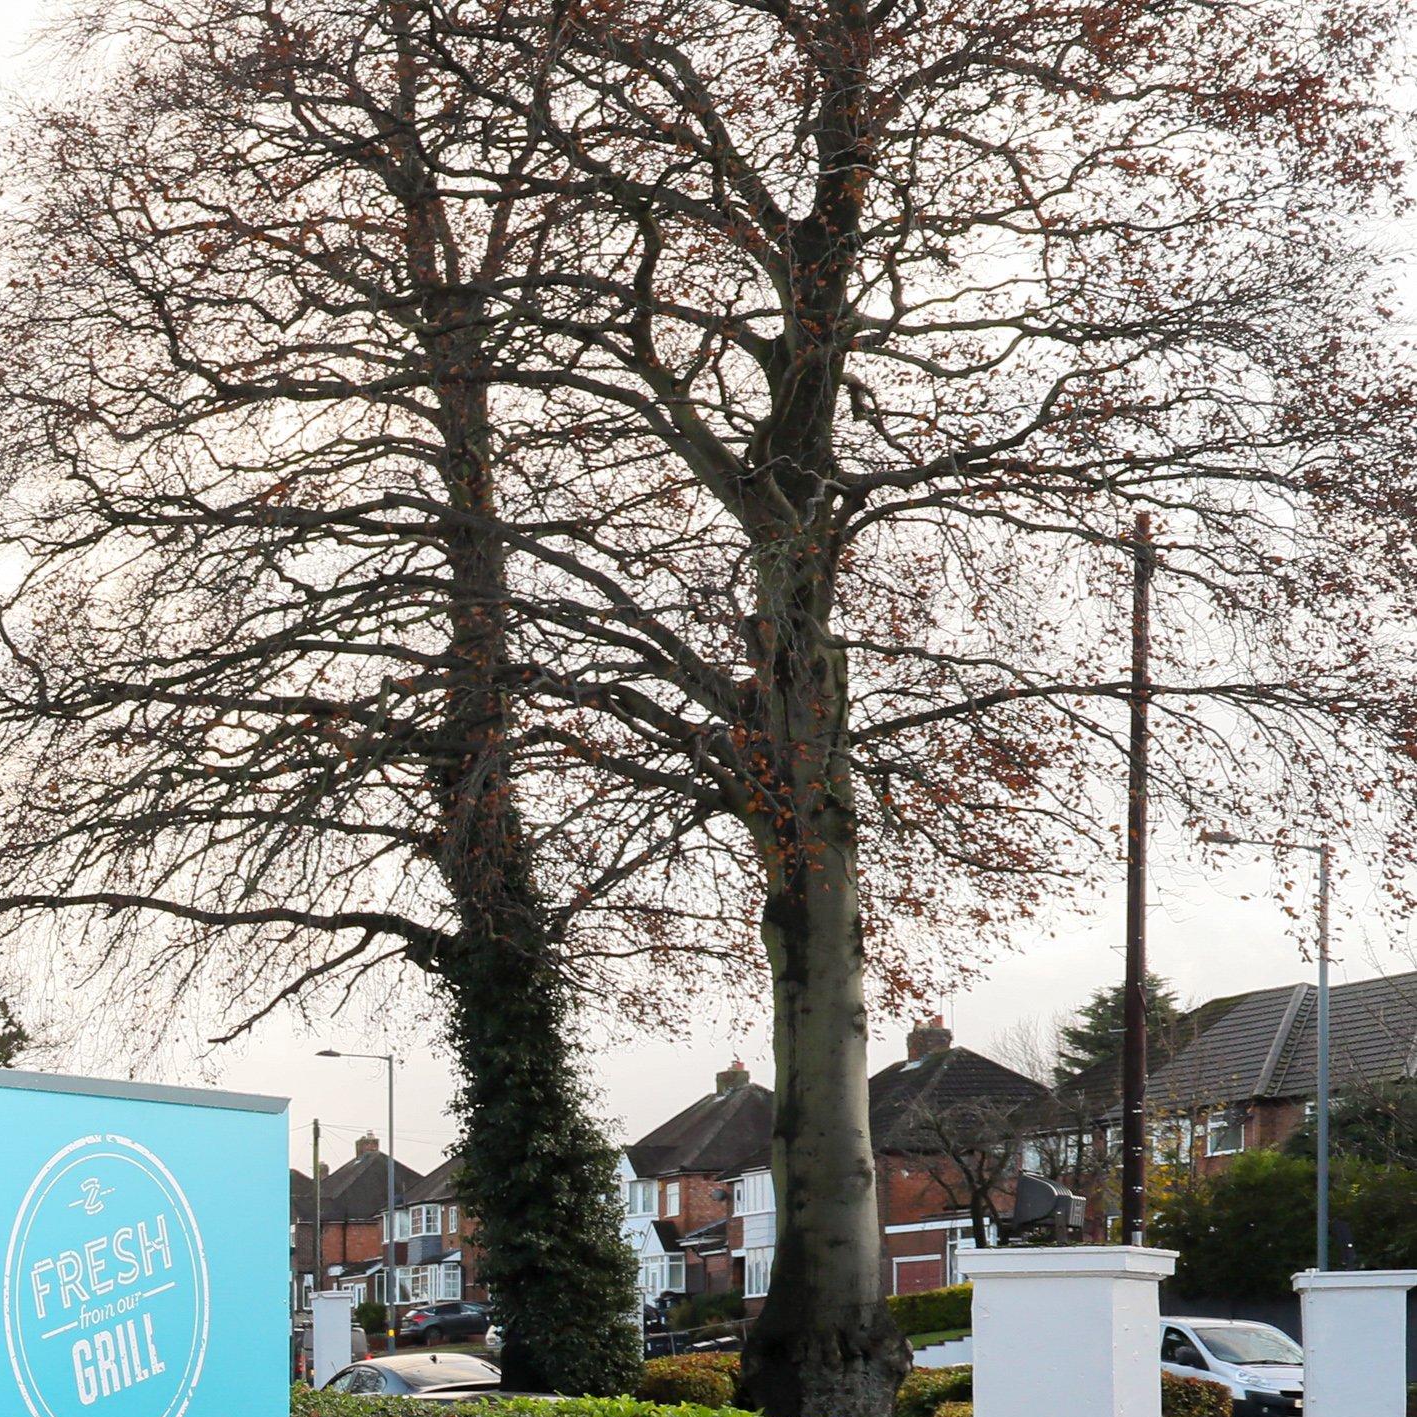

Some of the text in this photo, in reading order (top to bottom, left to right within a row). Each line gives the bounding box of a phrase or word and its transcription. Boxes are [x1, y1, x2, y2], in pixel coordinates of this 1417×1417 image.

[31, 1213, 173, 1320] FRESH
[79, 1291, 142, 1330] from our
[71, 1312, 166, 1406] GRILL
